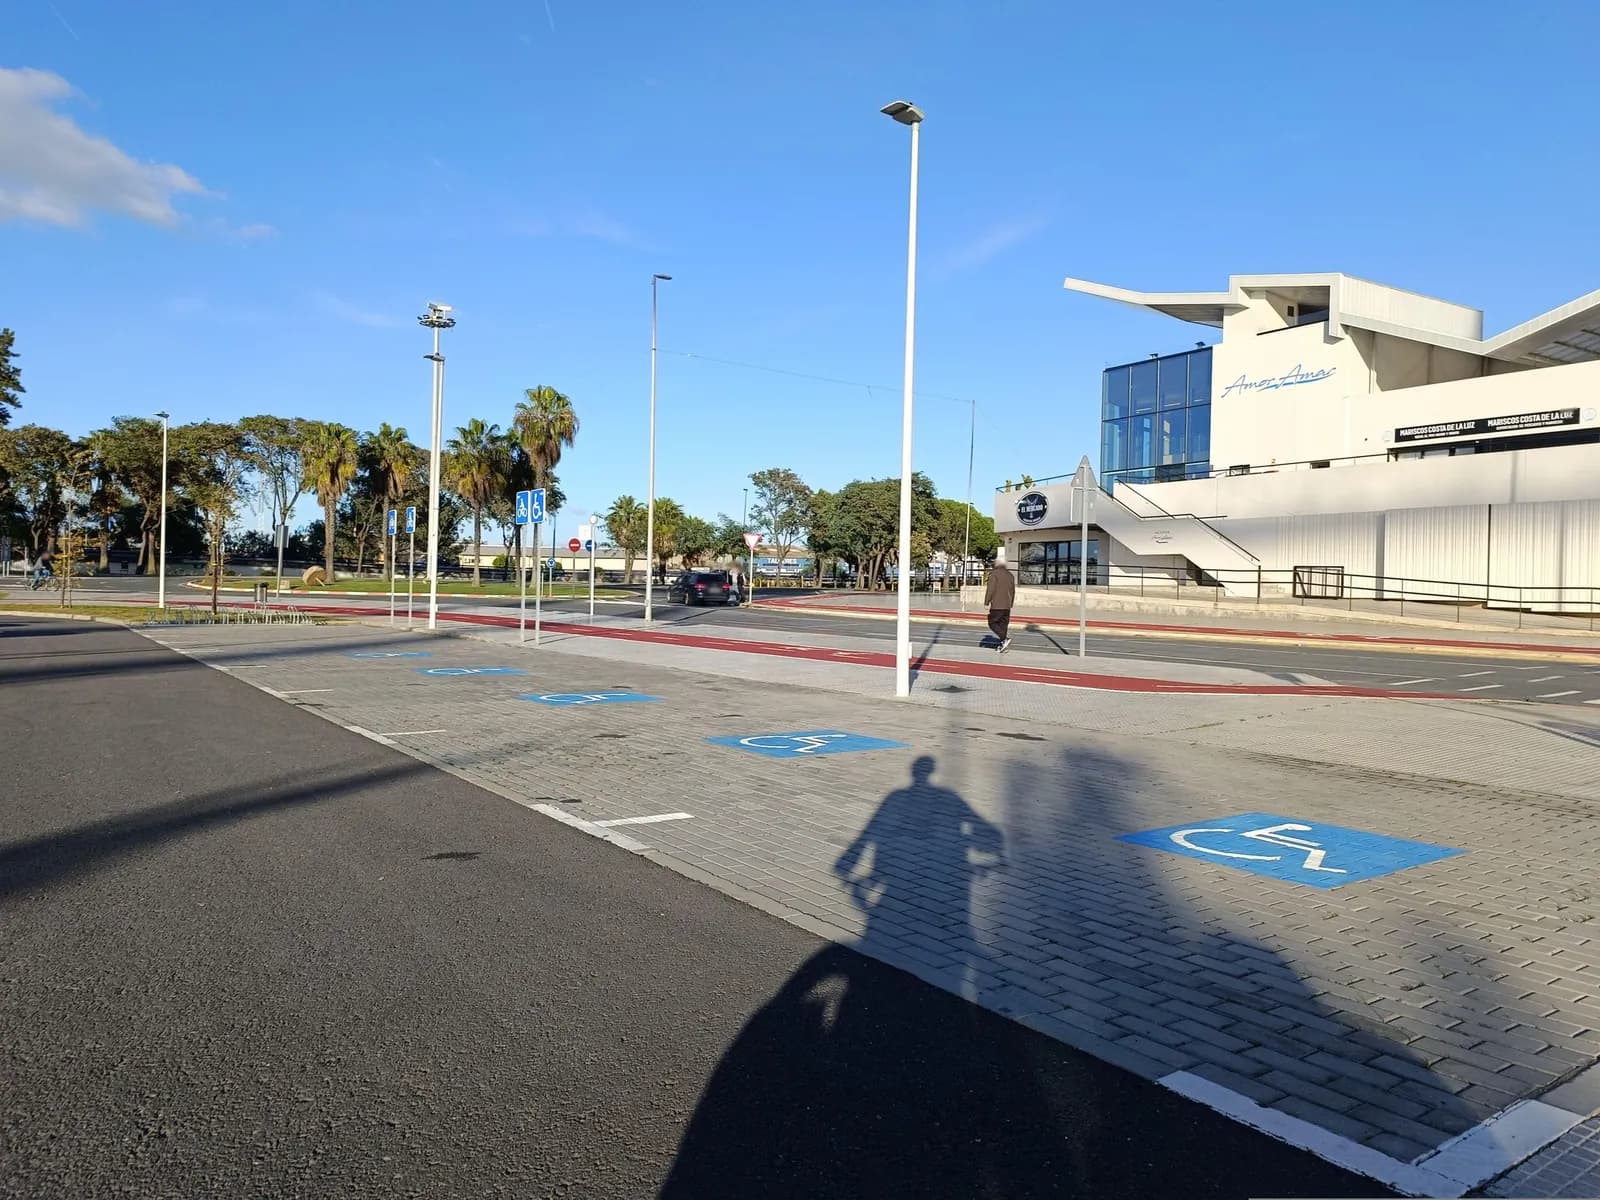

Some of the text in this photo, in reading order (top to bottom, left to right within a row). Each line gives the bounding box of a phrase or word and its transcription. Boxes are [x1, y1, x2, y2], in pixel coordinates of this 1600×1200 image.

[1221, 374, 1276, 398] Amor
[1488, 417, 1519, 427] MARISCOS
[1520, 414, 1540, 423] COSTA
[1541, 413, 1550, 421] DE
[1551, 412, 1559, 420] LA
[1560, 411, 1574, 419] LUZ
[1400, 427, 1428, 436] MARISCOS
[1428, 424, 1447, 433] COSTA
[1447, 423, 1455, 431] DE
[1455, 422, 1463, 430] LA
[1464, 421, 1475, 429] LUZ
